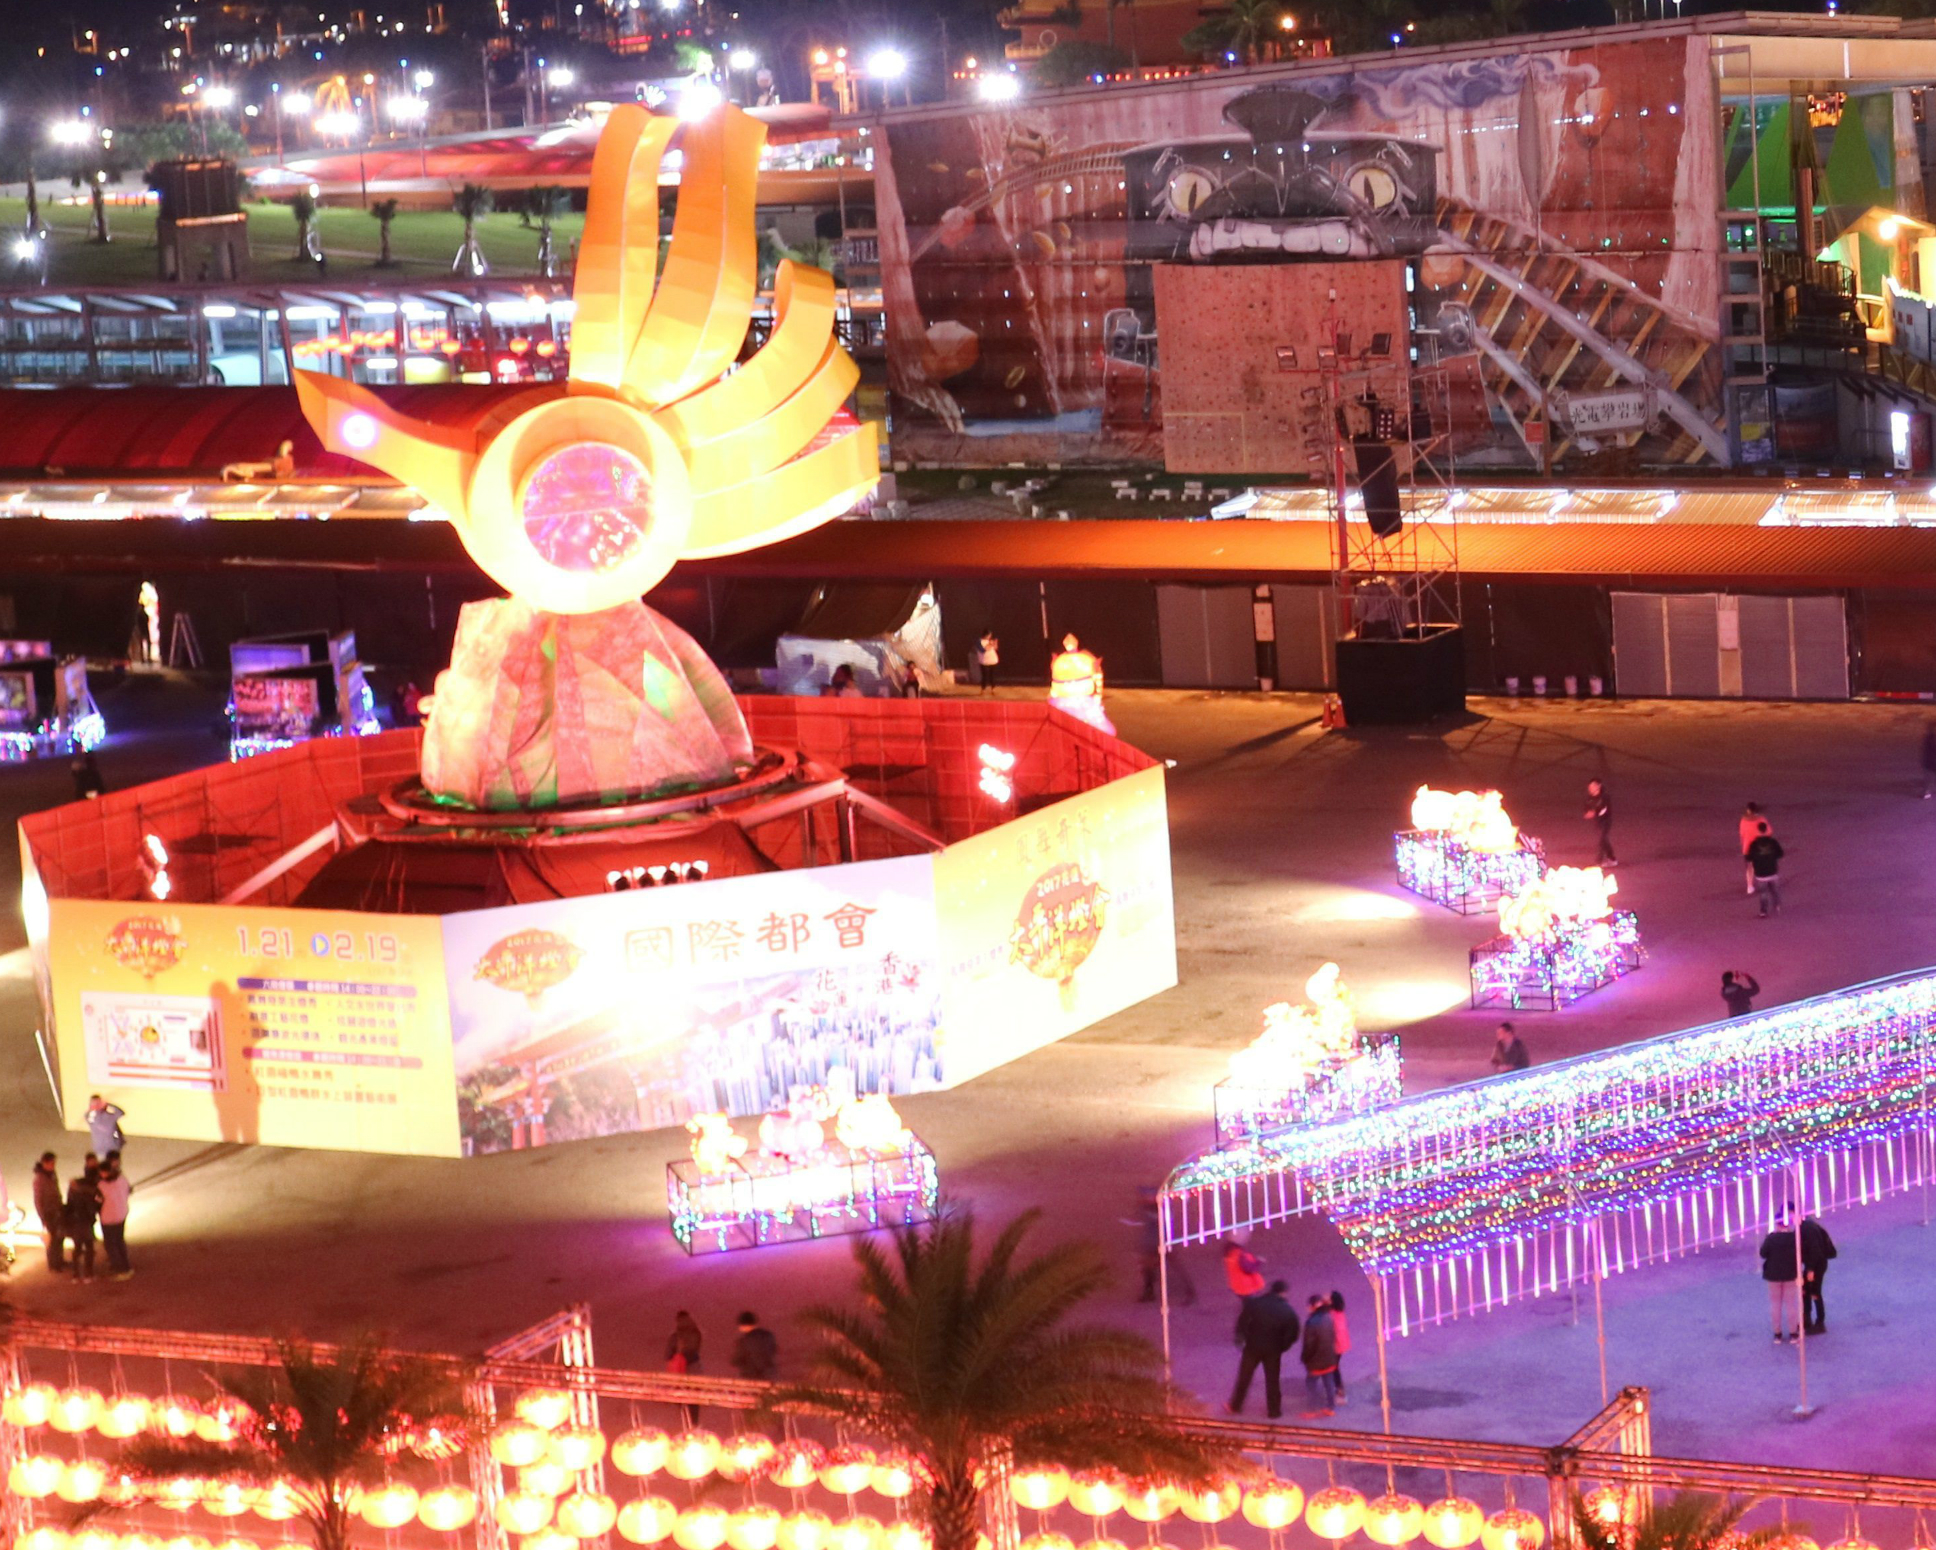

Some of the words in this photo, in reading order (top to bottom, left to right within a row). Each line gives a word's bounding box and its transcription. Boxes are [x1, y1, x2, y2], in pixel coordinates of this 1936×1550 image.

[238, 926, 293, 958] 1.21
[333, 932, 397, 963] 2.19
[625, 902, 877, 972] 國際都會
